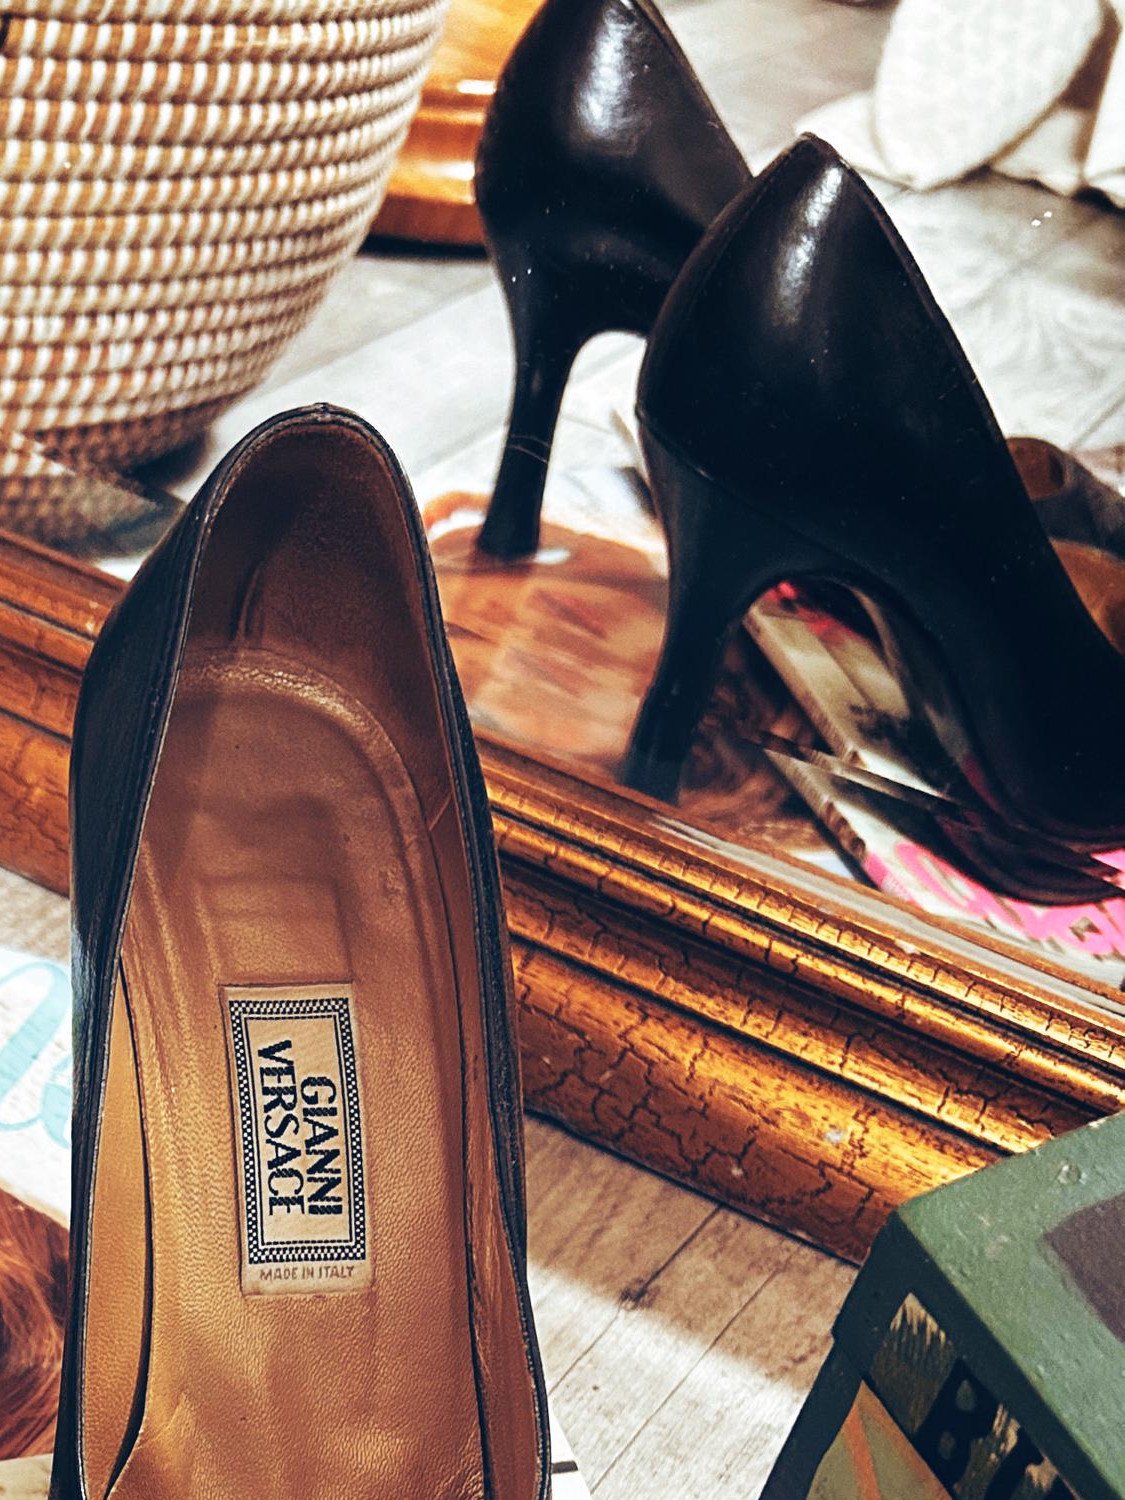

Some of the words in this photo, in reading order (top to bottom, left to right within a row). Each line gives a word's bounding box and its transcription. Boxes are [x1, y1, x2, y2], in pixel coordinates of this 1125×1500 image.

[258, 1040, 305, 1216] VERSACE
[300, 1077, 343, 1214] GIANNI
[260, 1266, 298, 1280] MADE
[302, 1265, 314, 1279] IN
[319, 1264, 354, 1279] ITALY
